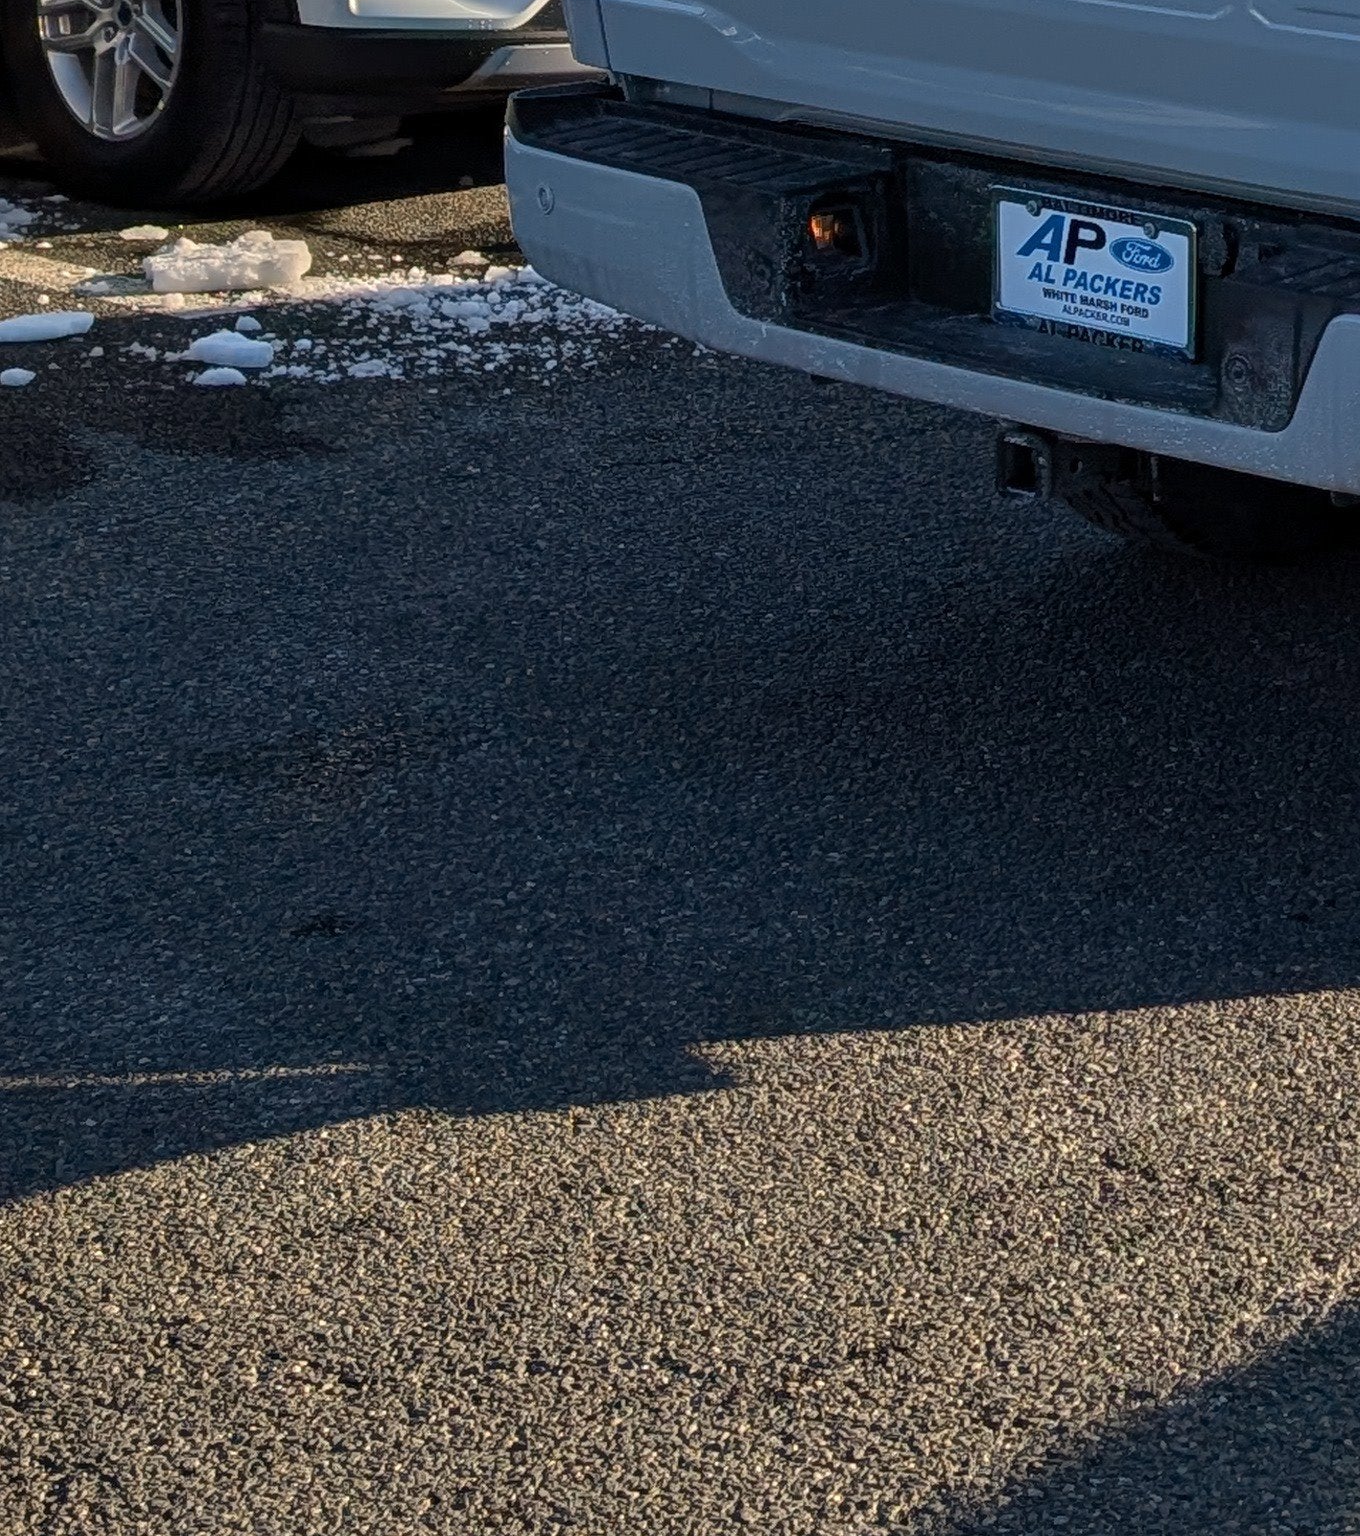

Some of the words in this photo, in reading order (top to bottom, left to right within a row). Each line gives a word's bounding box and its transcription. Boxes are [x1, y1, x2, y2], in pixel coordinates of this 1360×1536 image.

[1015, 213, 1107, 266] AP
[1120, 240, 1161, 269] Ford
[1027, 261, 1056, 285] AL
[1062, 267, 1162, 306] PACKERS
[1042, 287, 1077, 304] WHITE
[1079, 294, 1118, 312] MARSH
[1119, 303, 1149, 319] FORD
